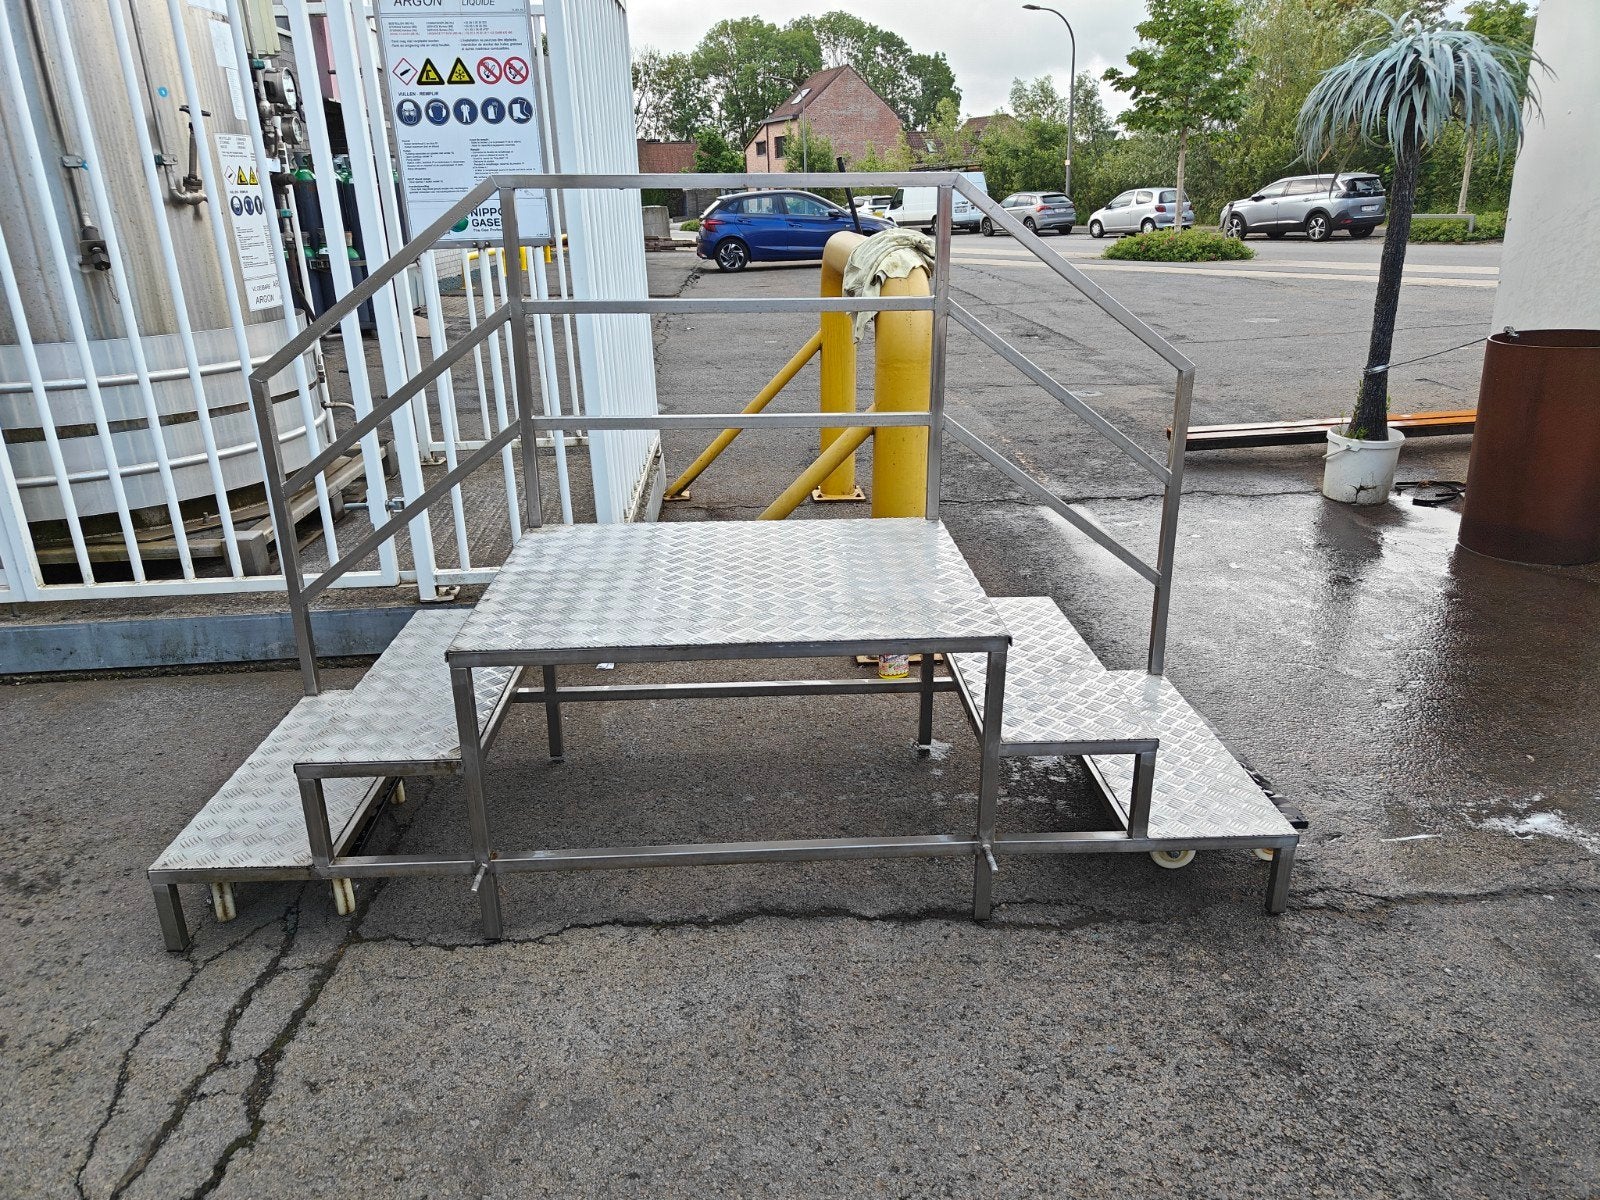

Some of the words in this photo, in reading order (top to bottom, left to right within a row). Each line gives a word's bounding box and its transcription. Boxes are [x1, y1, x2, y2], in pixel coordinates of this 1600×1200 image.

[470, 207, 503, 217] NIPP
[471, 217, 502, 227] GASE
[255, 293, 275, 305] ARGON
